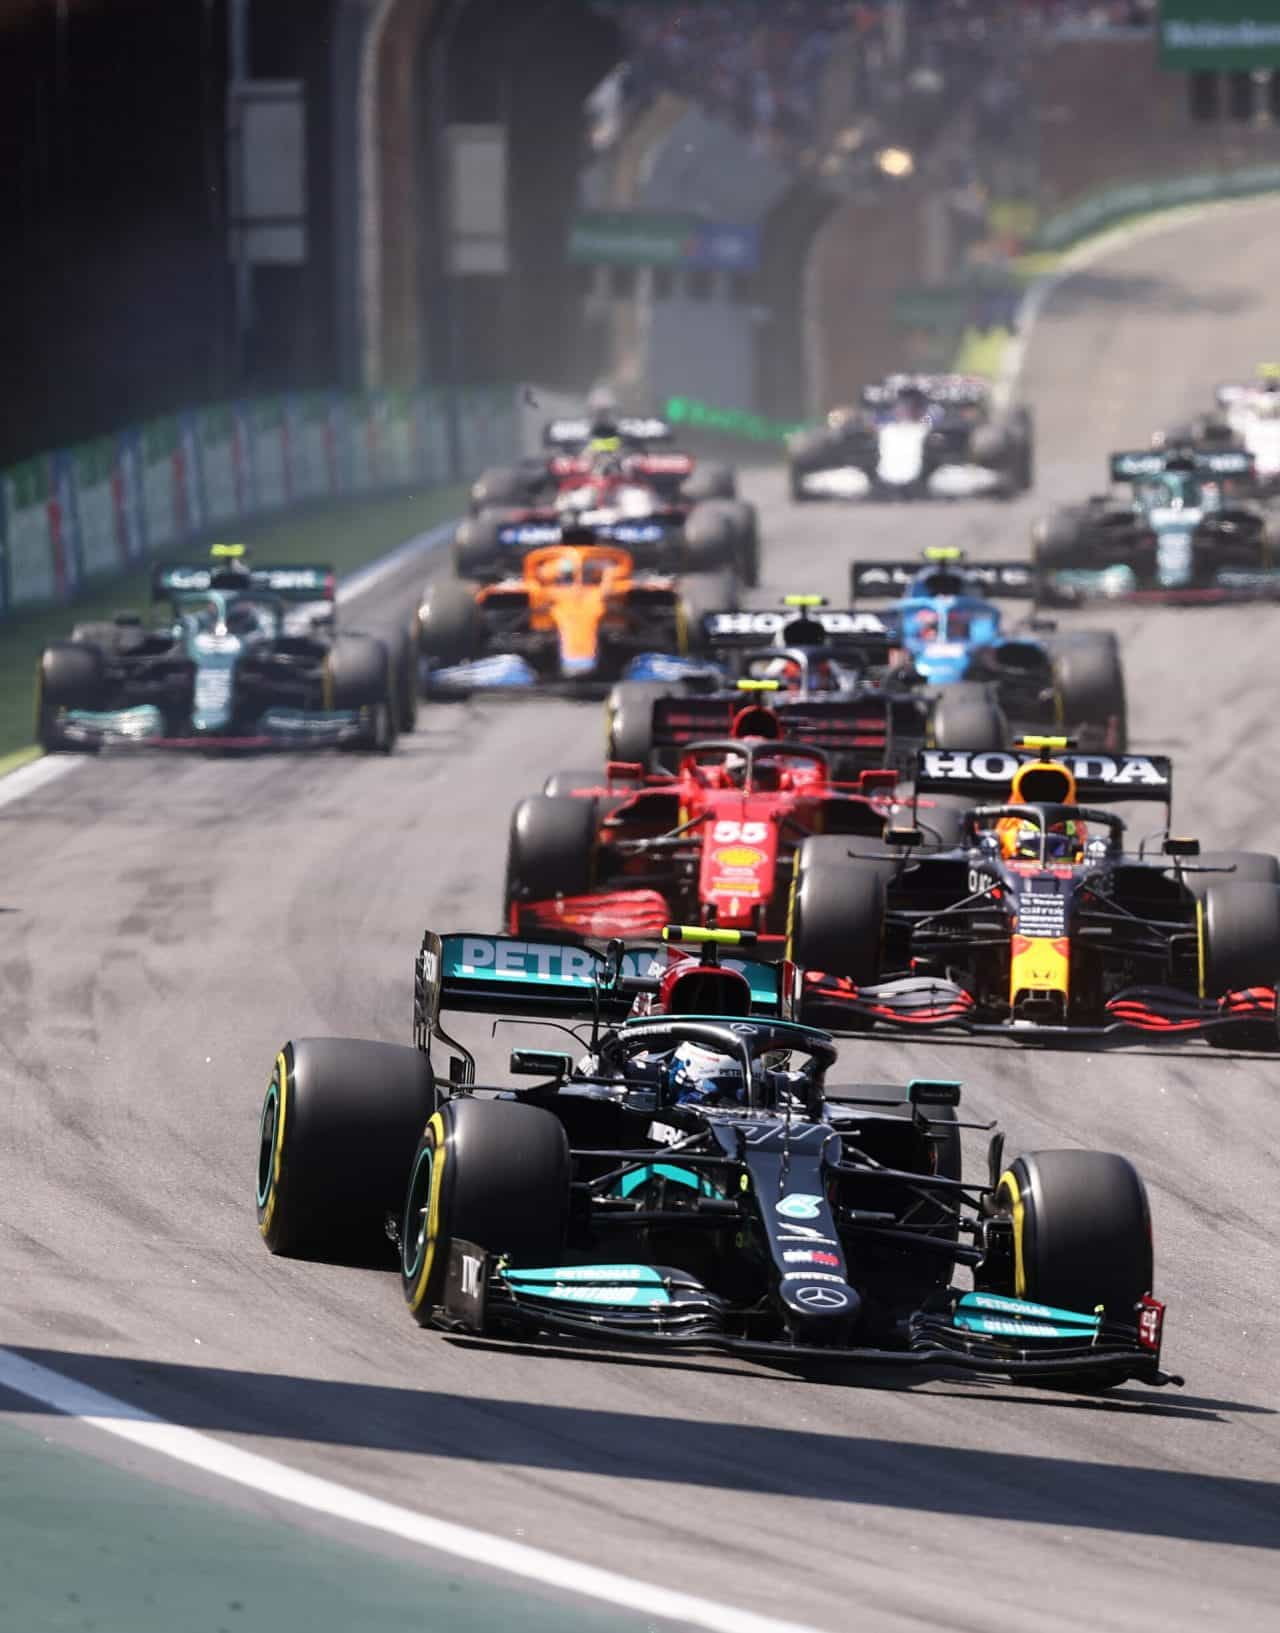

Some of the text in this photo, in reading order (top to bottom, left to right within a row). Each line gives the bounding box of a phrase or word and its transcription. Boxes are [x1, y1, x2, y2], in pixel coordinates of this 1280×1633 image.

[859, 567, 1030, 586] ALNE
[712, 612, 888, 633] HODA
[921, 751, 1168, 785] HODA
[713, 820, 768, 844] 55
